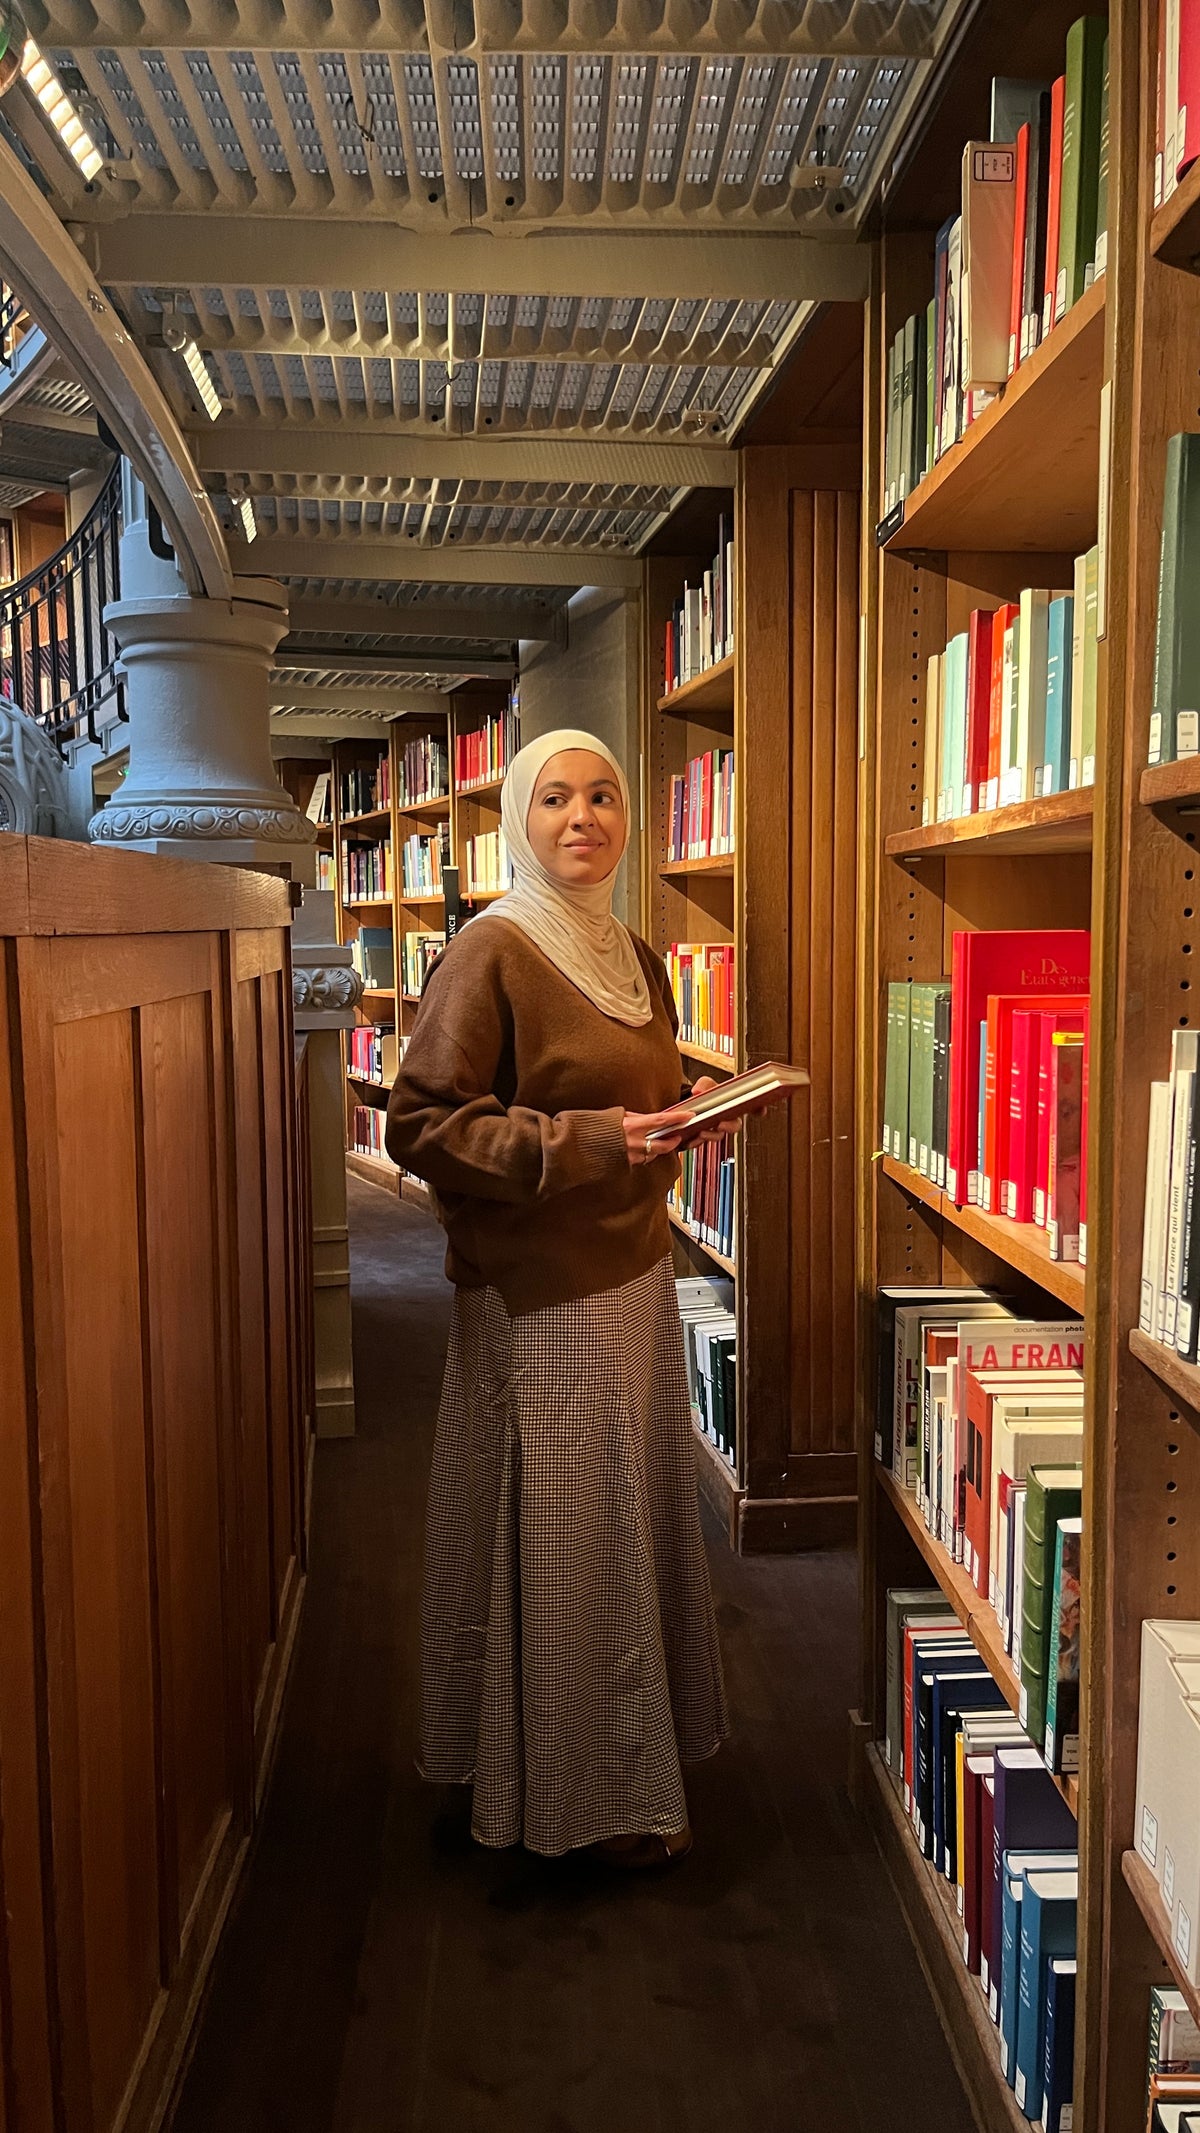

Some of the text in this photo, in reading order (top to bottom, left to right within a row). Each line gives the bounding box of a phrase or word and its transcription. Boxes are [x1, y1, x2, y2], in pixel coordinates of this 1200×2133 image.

[1041, 958, 1068, 974] Des
[1171, 1216, 1179, 1234] qui
[1169, 1238, 1177, 1275] France
[966, 1343, 1084, 1368] LA FRAN
